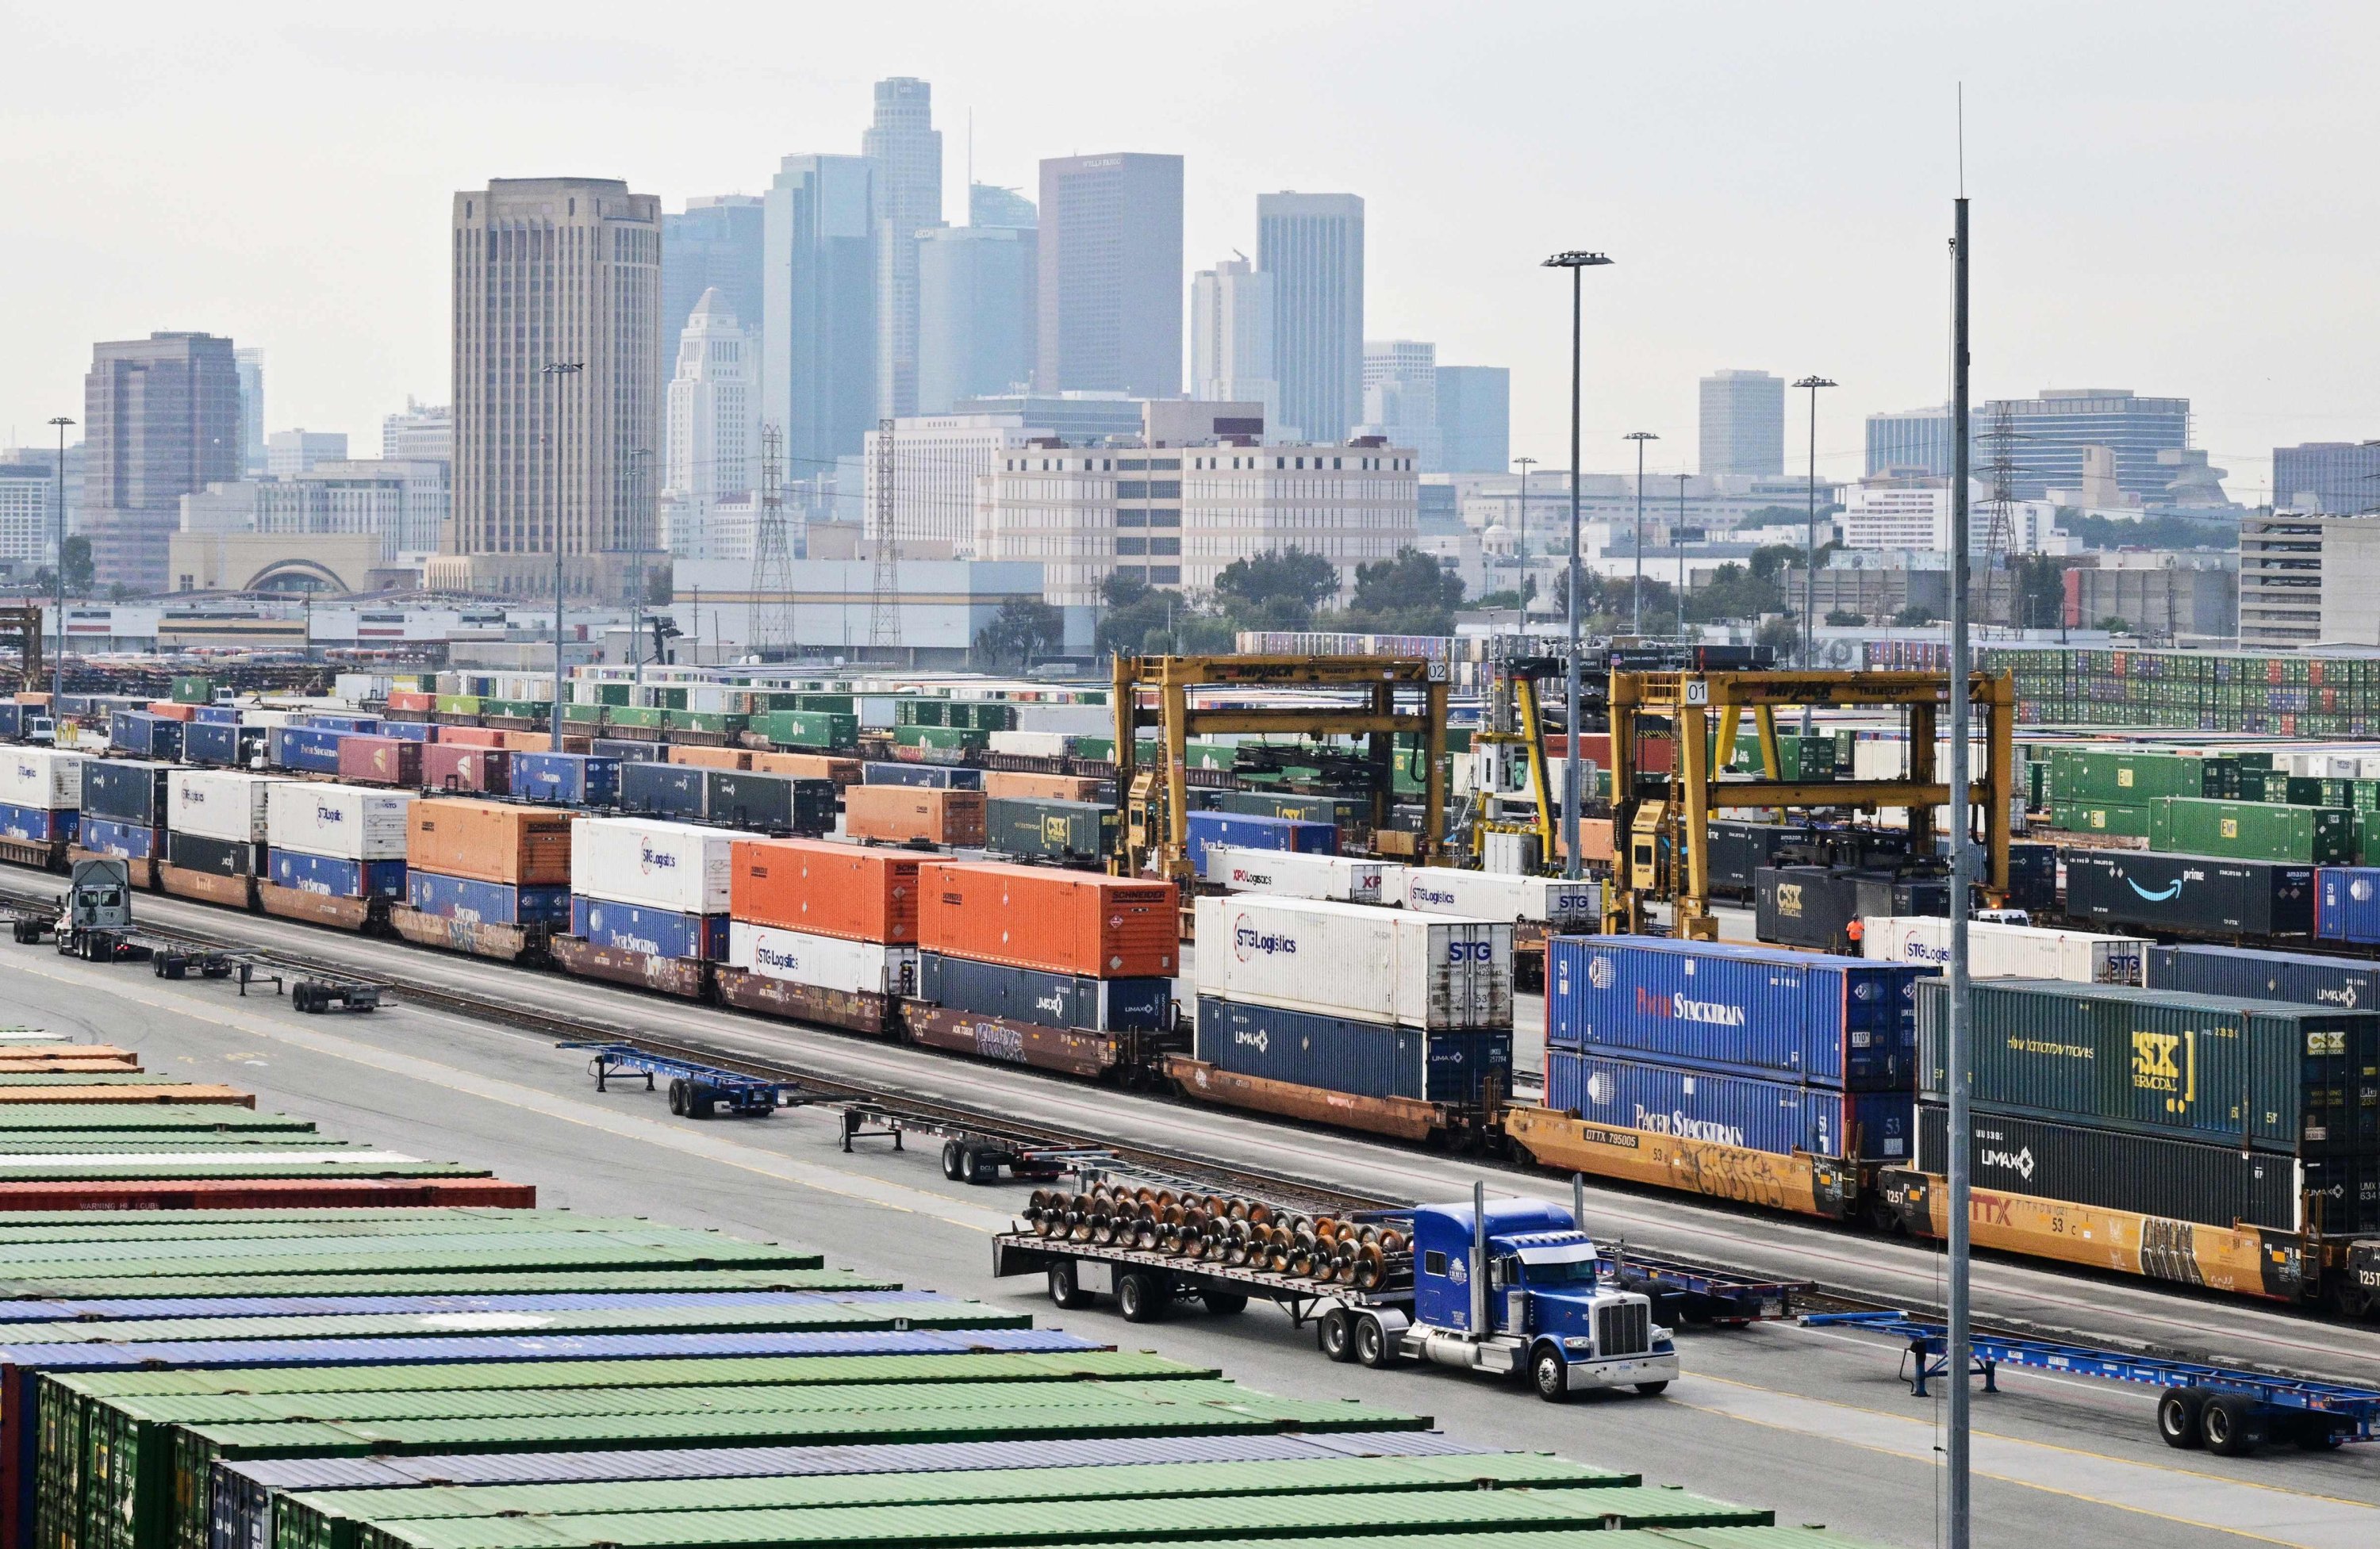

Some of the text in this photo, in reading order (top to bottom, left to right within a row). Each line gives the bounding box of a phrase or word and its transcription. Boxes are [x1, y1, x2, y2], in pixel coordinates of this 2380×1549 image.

[1429, 665, 1445, 679] 02
[1688, 684, 1706, 700] 01
[1362, 876, 1381, 888] XP
[2183, 868, 2204, 881] prime
[1112, 891, 1165, 899] SCHNEIDER
[1560, 895, 1587, 909] STG
[1777, 884, 1802, 910] CSX
[1449, 941, 1491, 961] STG
[2109, 956, 2140, 971] STG
[2307, 1032, 2345, 1049] CSX
[2132, 1074, 2177, 1091] ERMODAL
[1634, 1103, 1670, 1134] PACER
[1885, 1118, 1901, 1135] 53
[1586, 1129, 1637, 1148] DTTX 795005
[1653, 1148, 1662, 1161] 53
[1887, 1190, 1904, 1204] 125T
[2360, 1191, 2380, 1200] 634
[1969, 1194, 2012, 1227] TTX
[2052, 1217, 2063, 1232] 53
[2071, 1225, 2076, 1235] C
